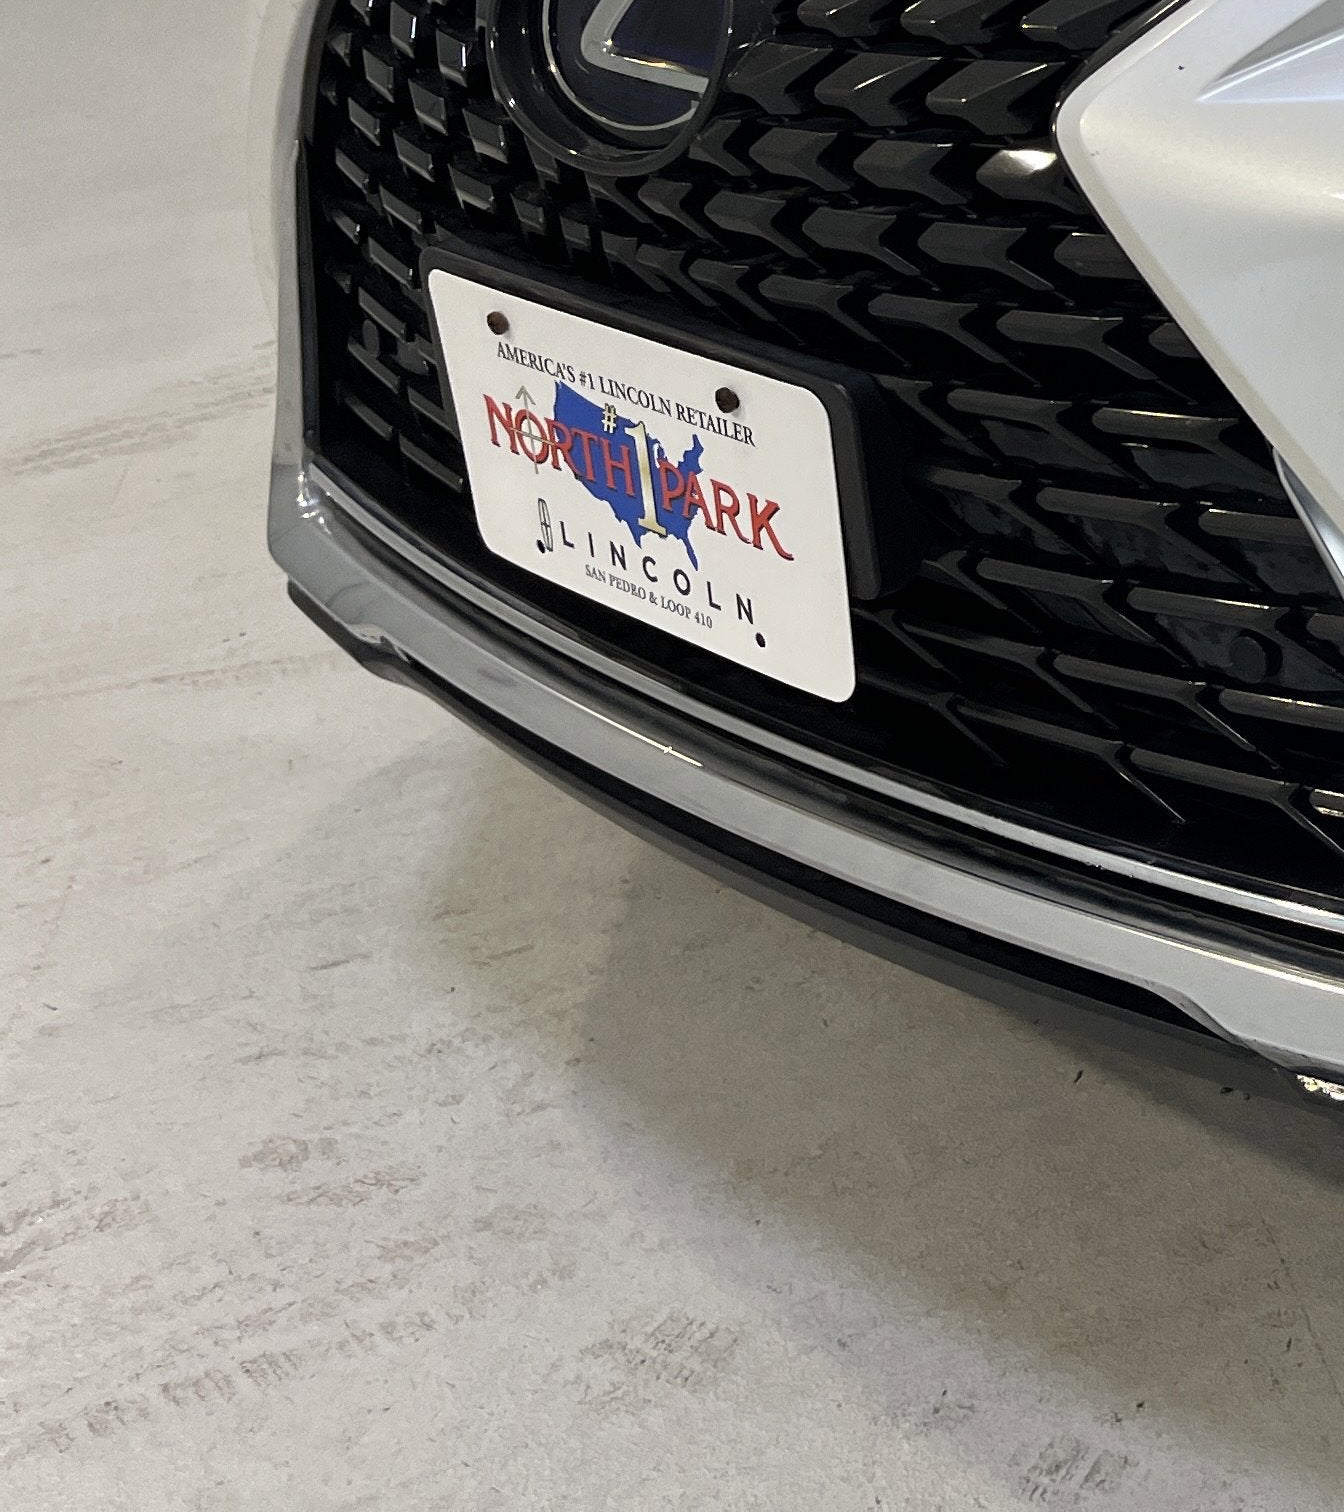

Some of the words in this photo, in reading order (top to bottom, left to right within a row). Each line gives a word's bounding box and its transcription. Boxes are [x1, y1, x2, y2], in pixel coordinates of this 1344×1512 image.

[497, 341, 576, 383] AMERICA'S
[579, 372, 596, 390] #1
[599, 375, 671, 417] LINCOLN
[676, 403, 755, 446] RETAILER
[483, 394, 636, 498] NORTH
[658, 461, 794, 561] PARK
[561, 522, 754, 625] LINCOLN
[585, 565, 606, 583] SAN
[609, 573, 646, 600] PEDRO
[649, 592, 658, 605] &
[660, 596, 691, 619] LOOP
[694, 611, 713, 629] 410
